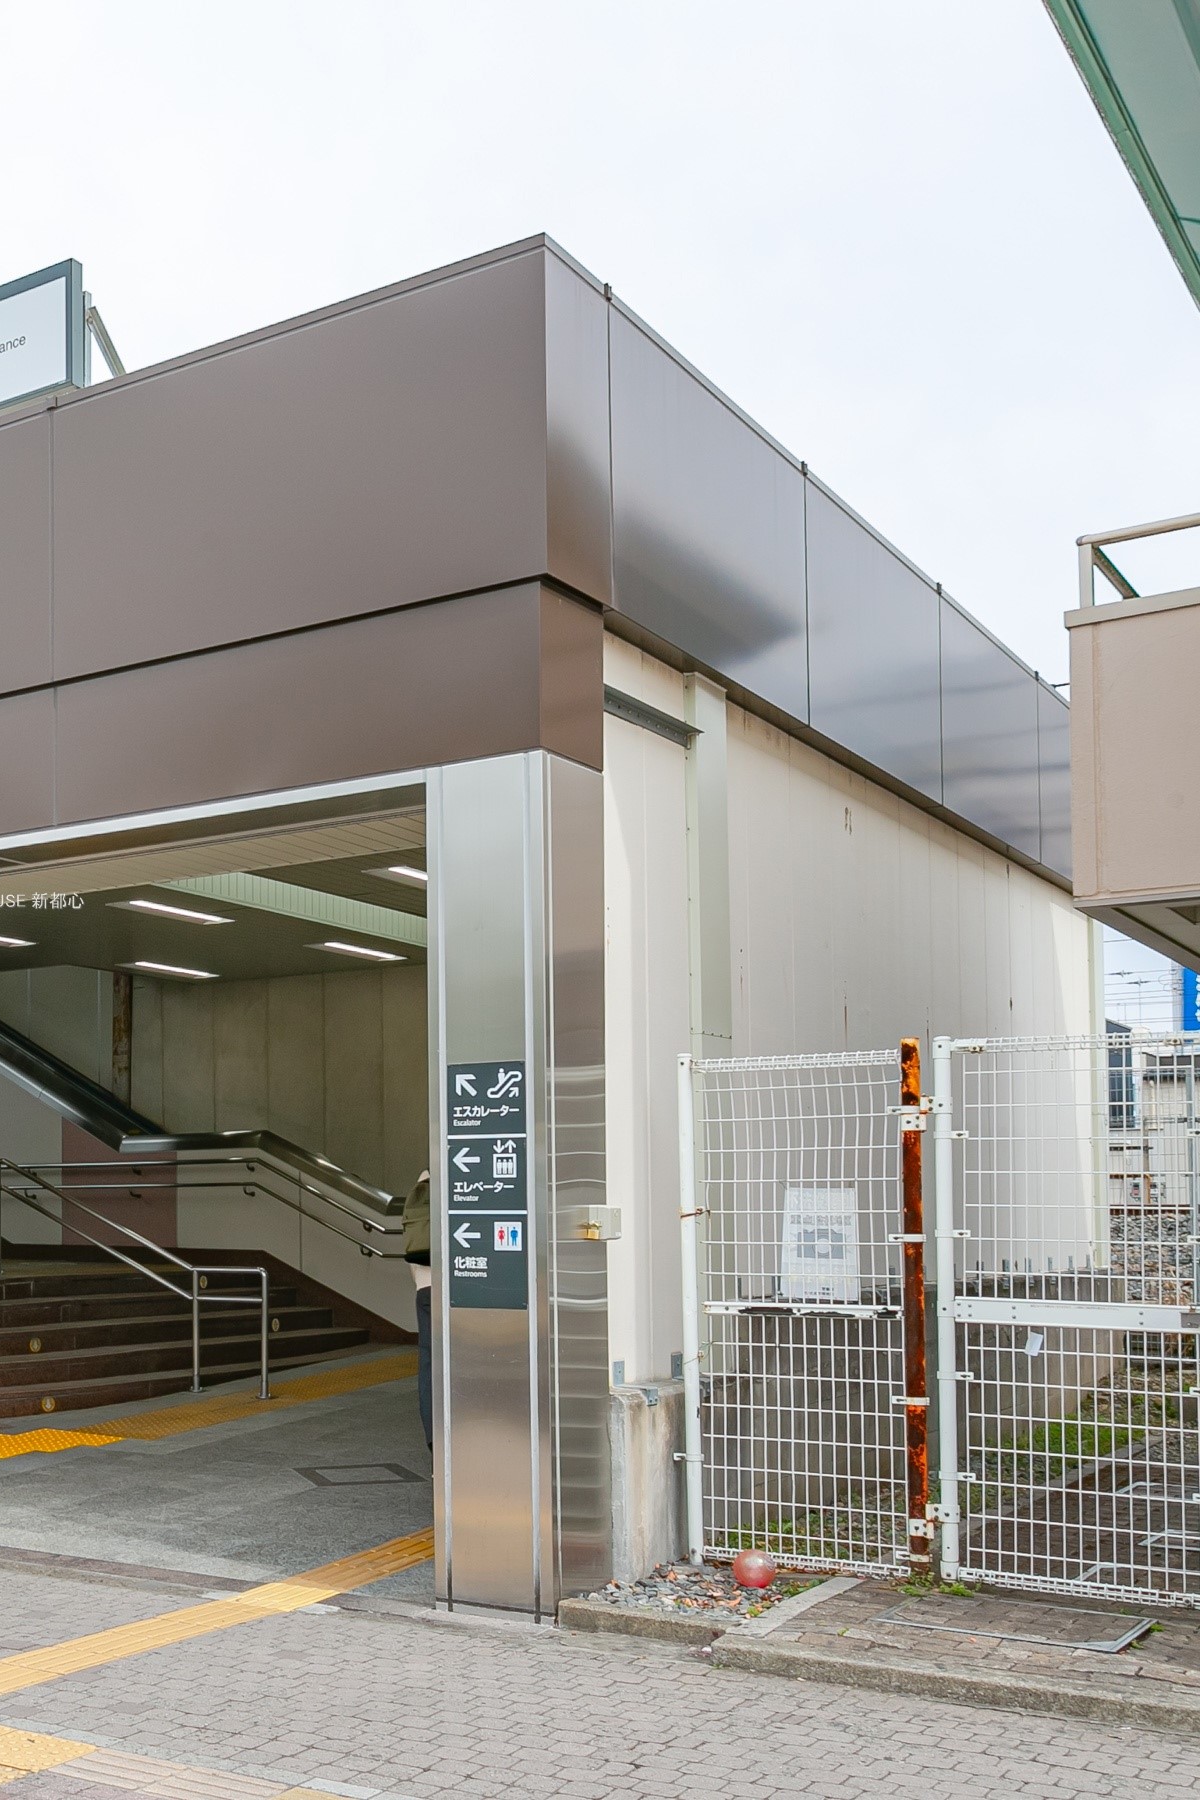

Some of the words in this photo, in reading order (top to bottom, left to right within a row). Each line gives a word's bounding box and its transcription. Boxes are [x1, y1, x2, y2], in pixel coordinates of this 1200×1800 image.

[453, 1104, 520, 1118] エスカレーター
[453, 1119, 482, 1127] Escalator
[453, 1180, 515, 1193] エレベーター
[453, 1194, 480, 1202] Elevator
[453, 1256, 488, 1269] 化粧室
[453, 1269, 488, 1278] Restrooms
